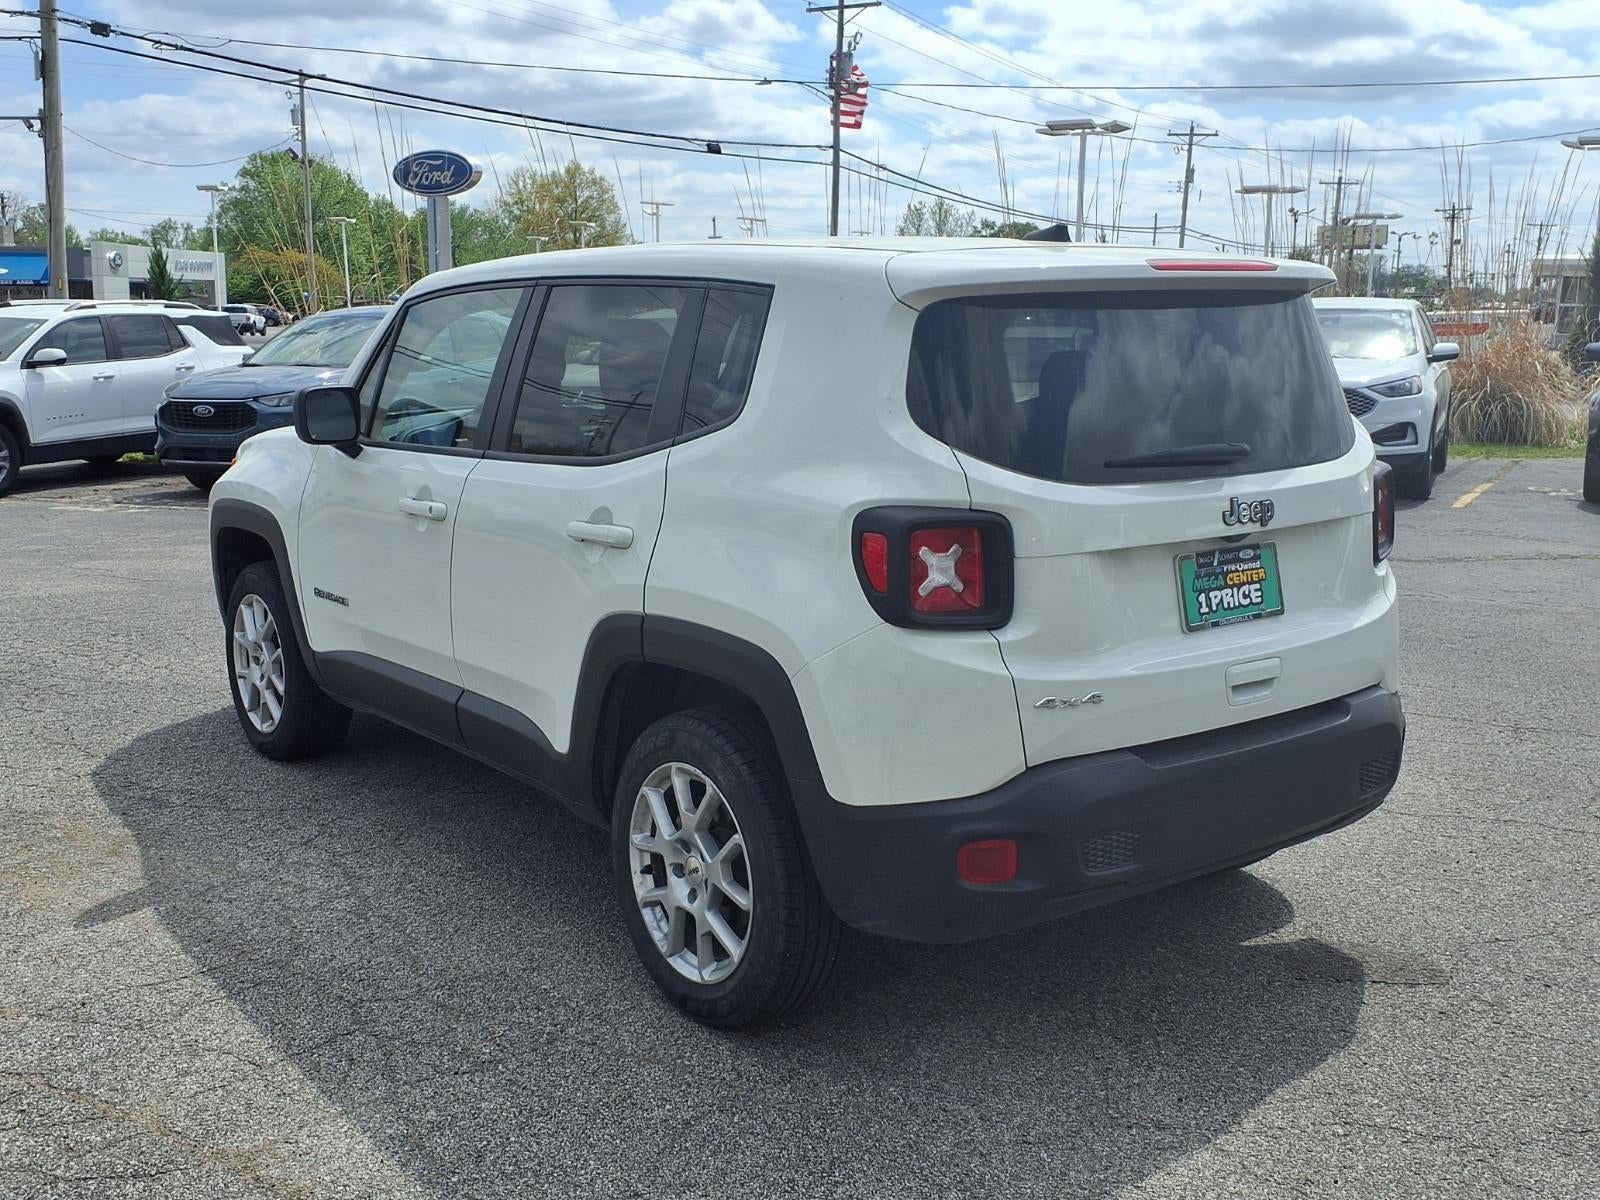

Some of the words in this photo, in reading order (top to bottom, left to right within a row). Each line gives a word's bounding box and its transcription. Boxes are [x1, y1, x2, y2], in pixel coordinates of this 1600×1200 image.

[408, 159, 455, 186] Ford
[1222, 496, 1275, 527] Jeep
[1193, 574, 1225, 591] MEGA
[1226, 568, 1266, 584] CENTER
[1198, 592, 1210, 613] 1
[1209, 583, 1262, 611] PRICE
